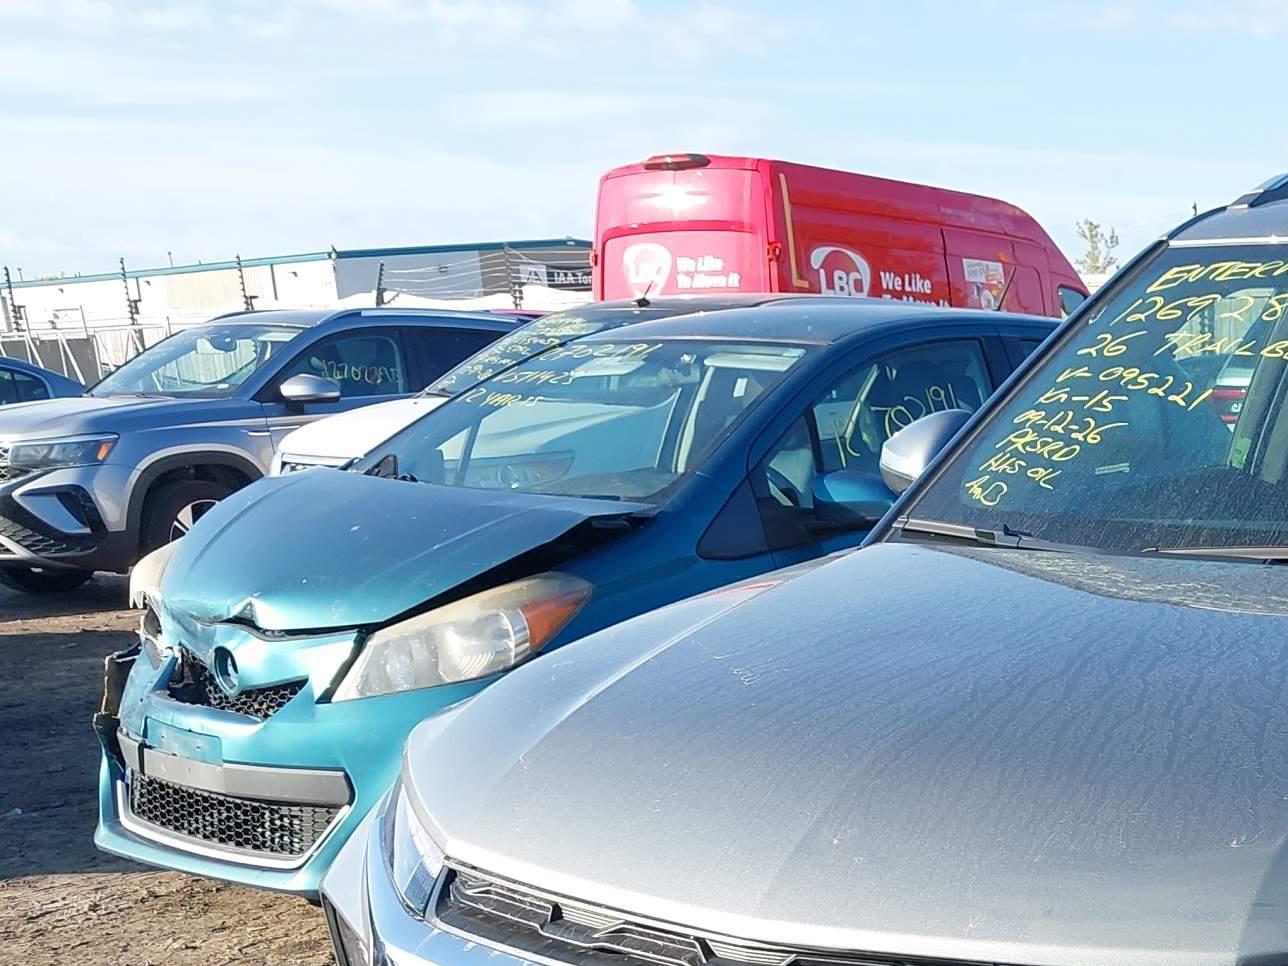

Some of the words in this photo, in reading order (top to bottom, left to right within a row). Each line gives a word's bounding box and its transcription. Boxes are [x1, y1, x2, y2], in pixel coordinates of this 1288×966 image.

[819, 268, 866, 297] LBC
[880, 271, 902, 292] We
[904, 273, 932, 294] Like
[1077, 331, 1148, 357] 26
